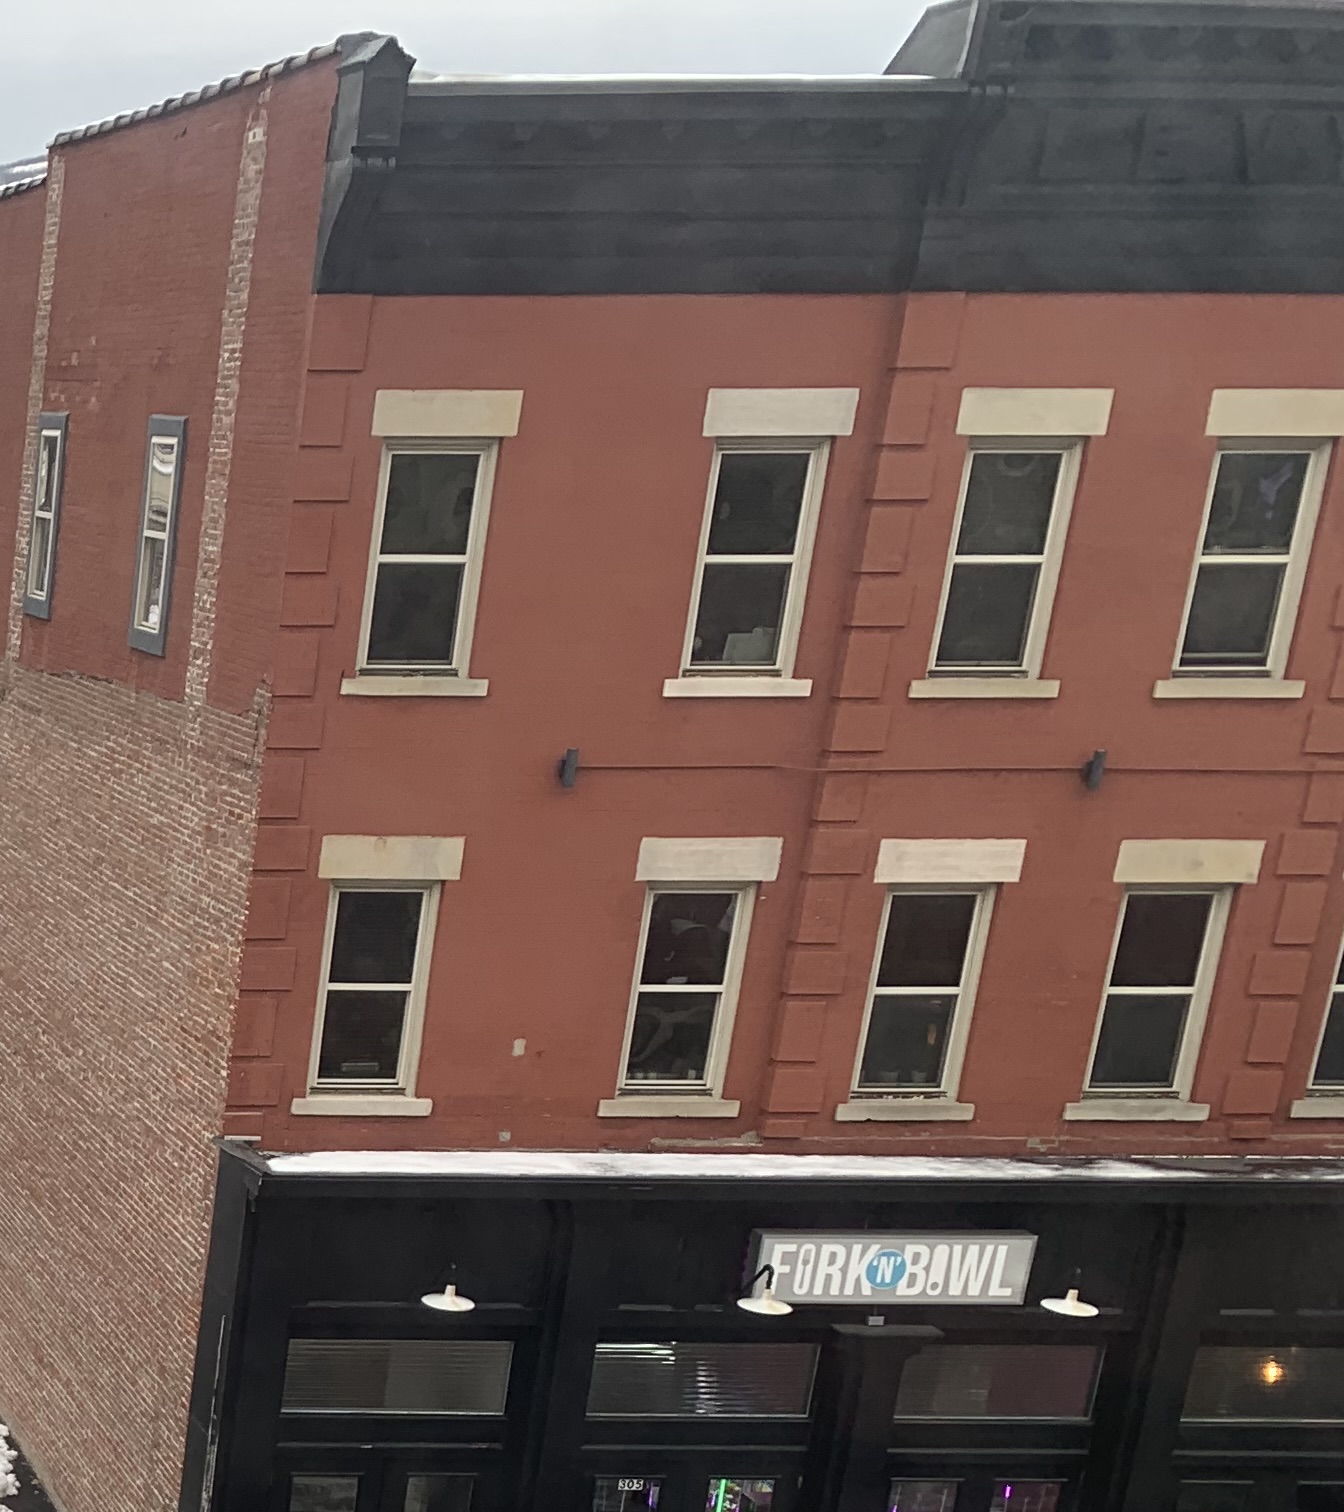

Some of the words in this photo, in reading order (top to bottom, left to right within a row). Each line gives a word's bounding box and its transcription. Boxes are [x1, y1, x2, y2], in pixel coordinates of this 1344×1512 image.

[769, 1244, 876, 1296] FORK
[896, 1245, 1012, 1296] BOWL
[618, 1479, 643, 1490] 305
